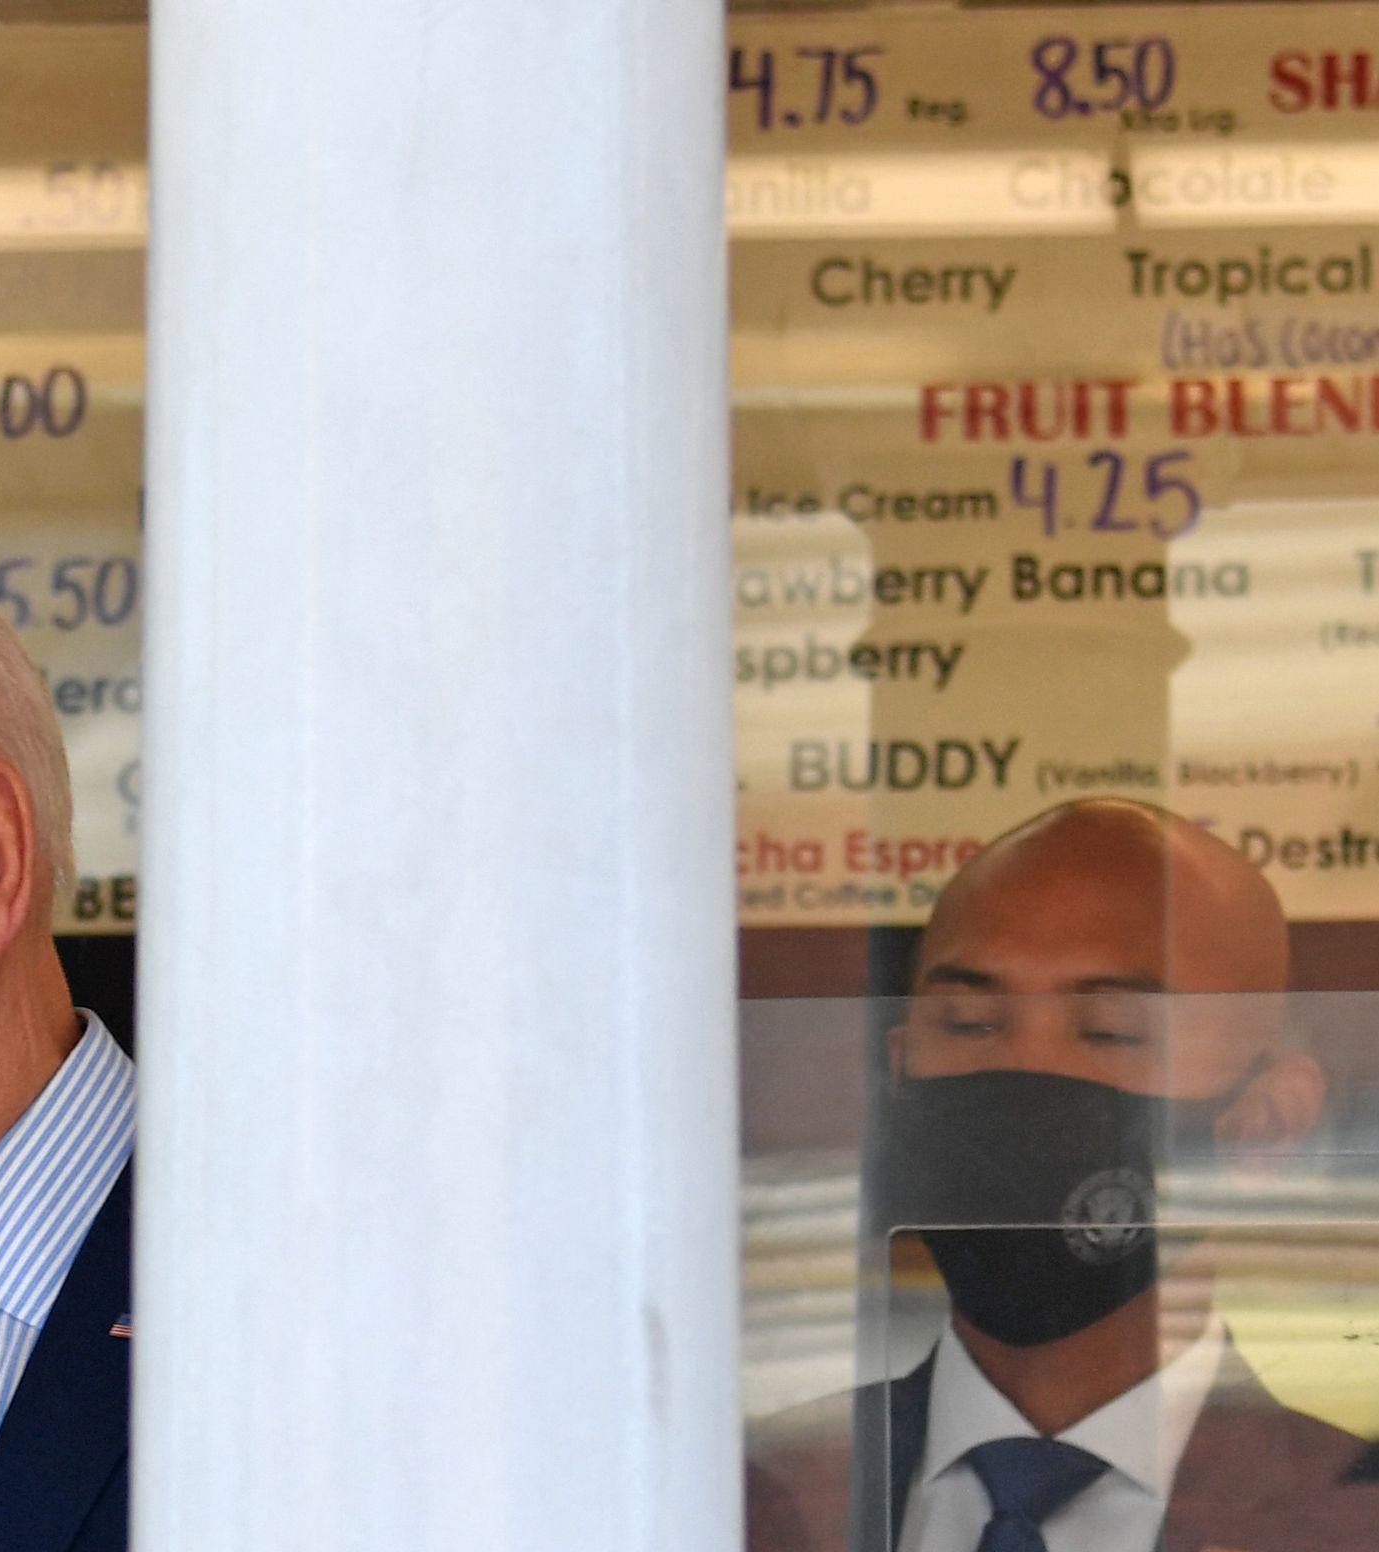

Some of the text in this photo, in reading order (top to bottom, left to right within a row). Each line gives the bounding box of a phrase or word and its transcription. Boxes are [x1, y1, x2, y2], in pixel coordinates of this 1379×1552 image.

[1031, 36, 1176, 121] 8.50
[1268, 49, 1379, 114] SH
[729, 150, 1338, 216] anilla Chocolate
[811, 244, 1373, 314] Cherry Tropical
[918, 375, 1379, 443] FRUIT BLEN
[746, 483, 1000, 523] Ice Cream
[736, 554, 1250, 616] awberry Banana
[735, 634, 965, 694] spberry
[787, 736, 1022, 795] BUDDY
[736, 830, 825, 876] cha
[1239, 824, 1379, 871] Destr
